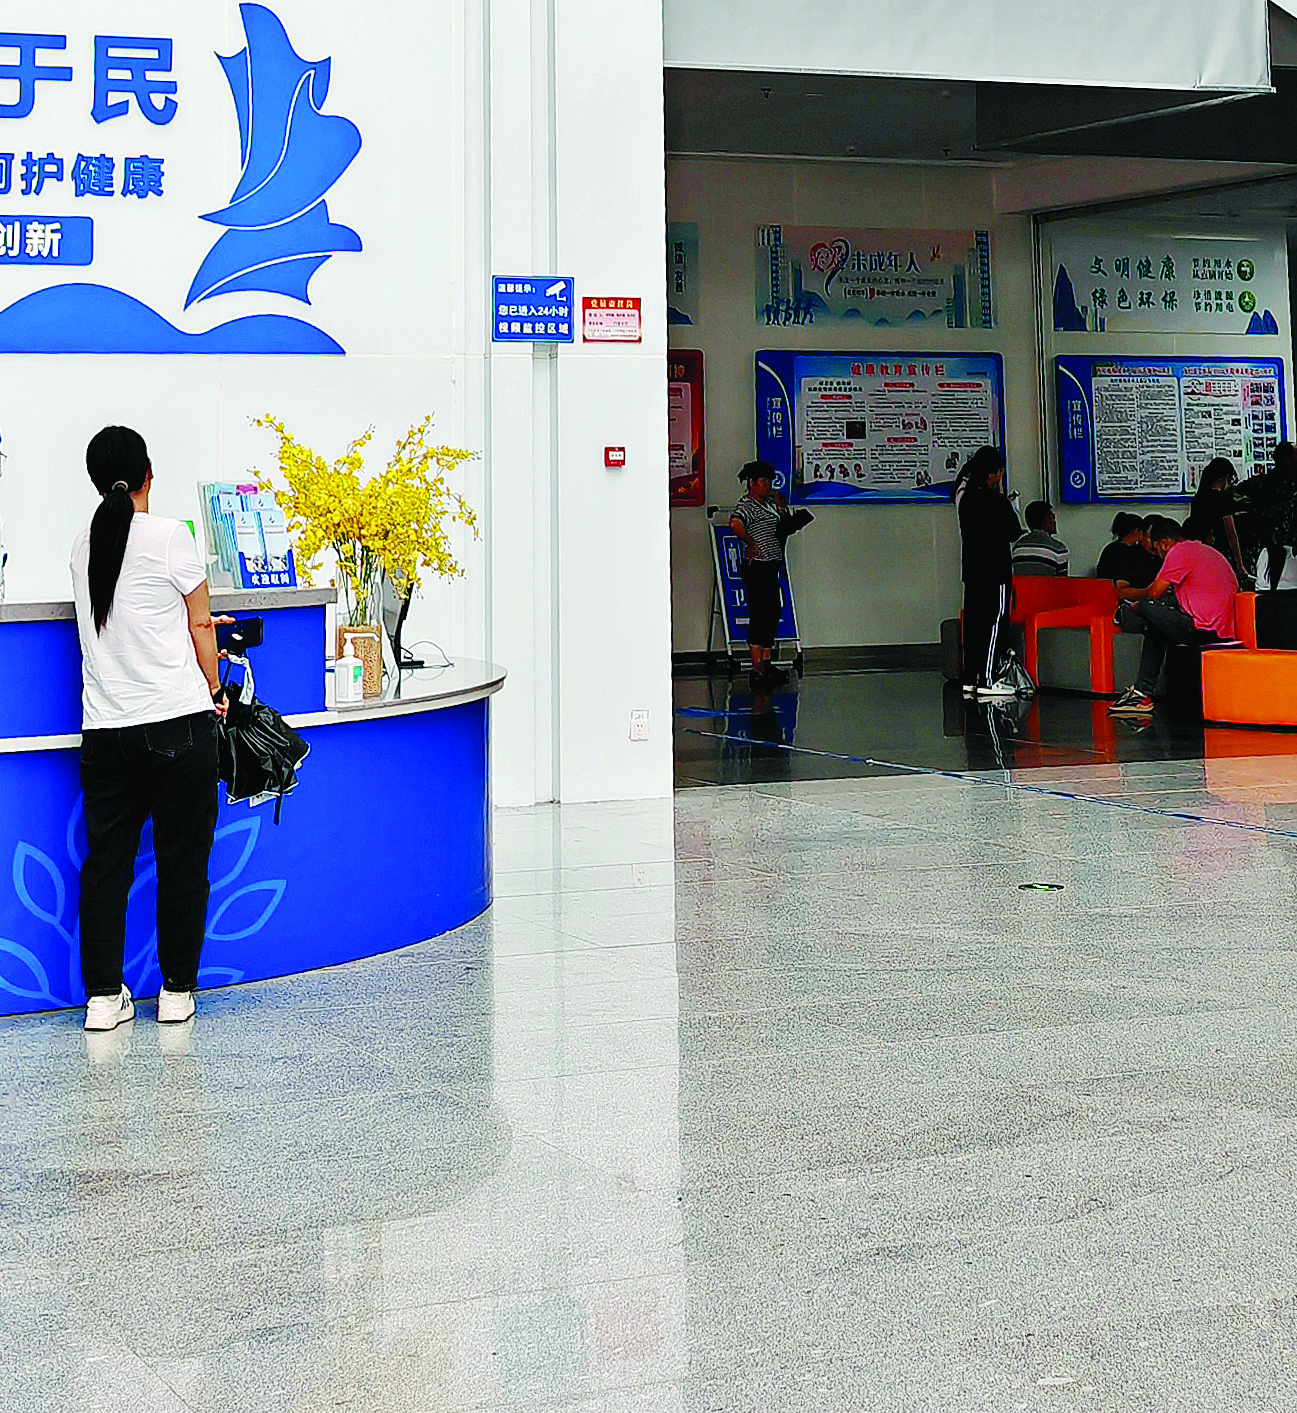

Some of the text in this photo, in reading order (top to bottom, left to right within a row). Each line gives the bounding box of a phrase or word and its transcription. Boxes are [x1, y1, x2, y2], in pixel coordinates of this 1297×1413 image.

[1090, 254, 1176, 281] 文明健康
[1091, 287, 1178, 311] 绿色环保
[498, 304, 570, 318] 您已进入24小时
[498, 322, 569, 335] 视频监控区域
